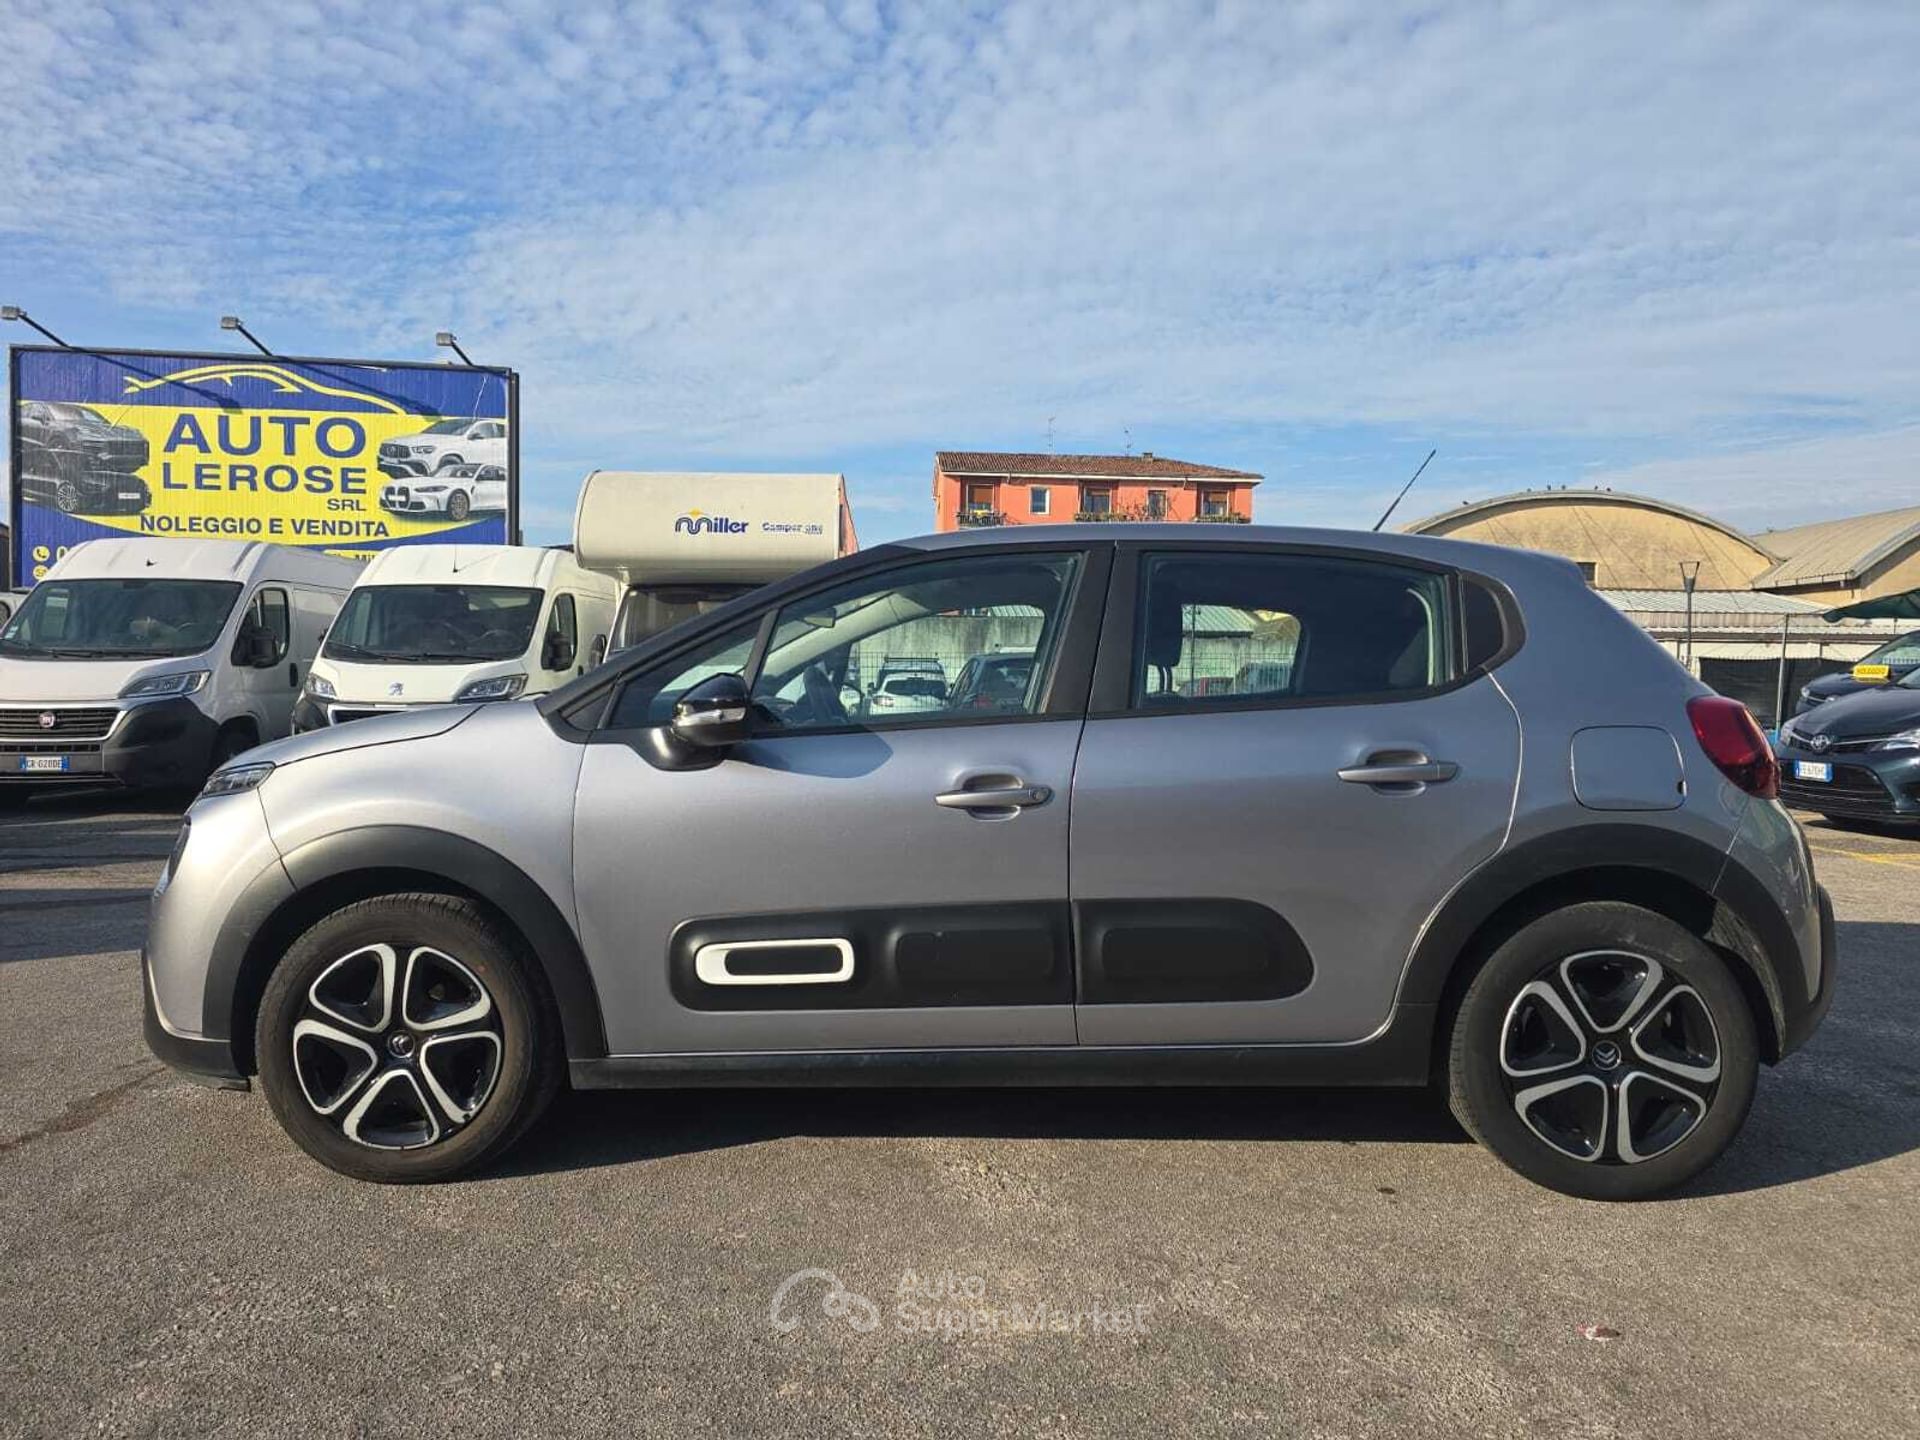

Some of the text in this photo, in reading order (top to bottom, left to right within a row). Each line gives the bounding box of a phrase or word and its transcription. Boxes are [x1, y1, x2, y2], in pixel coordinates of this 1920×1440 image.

[163, 413, 366, 459] AUTO
[163, 462, 367, 494] LEROSE
[327, 498, 367, 511] SRL
[140, 515, 389, 537] NOLEGGIO E VENDITA
